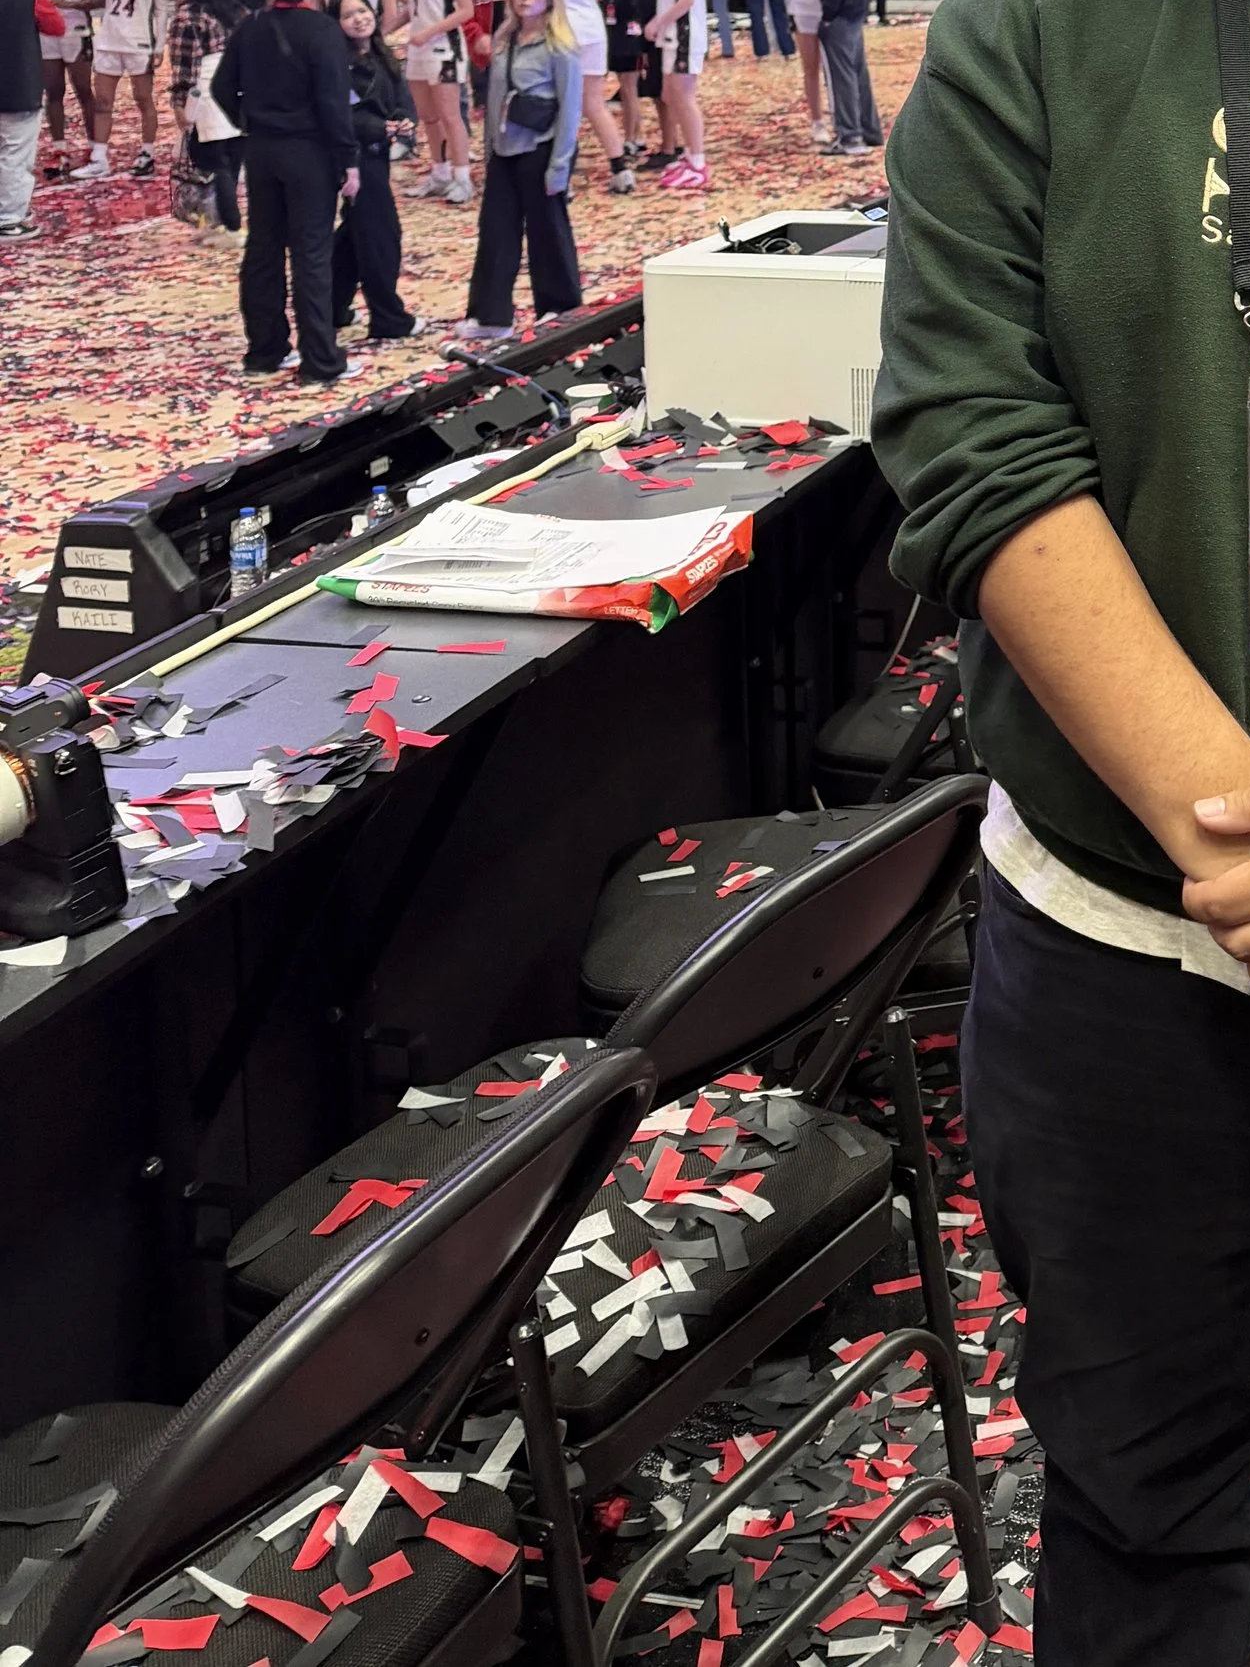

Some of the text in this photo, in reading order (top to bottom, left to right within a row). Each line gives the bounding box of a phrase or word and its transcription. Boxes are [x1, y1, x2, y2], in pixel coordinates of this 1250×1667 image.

[75, 552, 108, 567] NATE
[685, 555, 719, 585] STAPLES
[73, 580, 108, 597] RORY
[72, 611, 118, 627] KAILI
